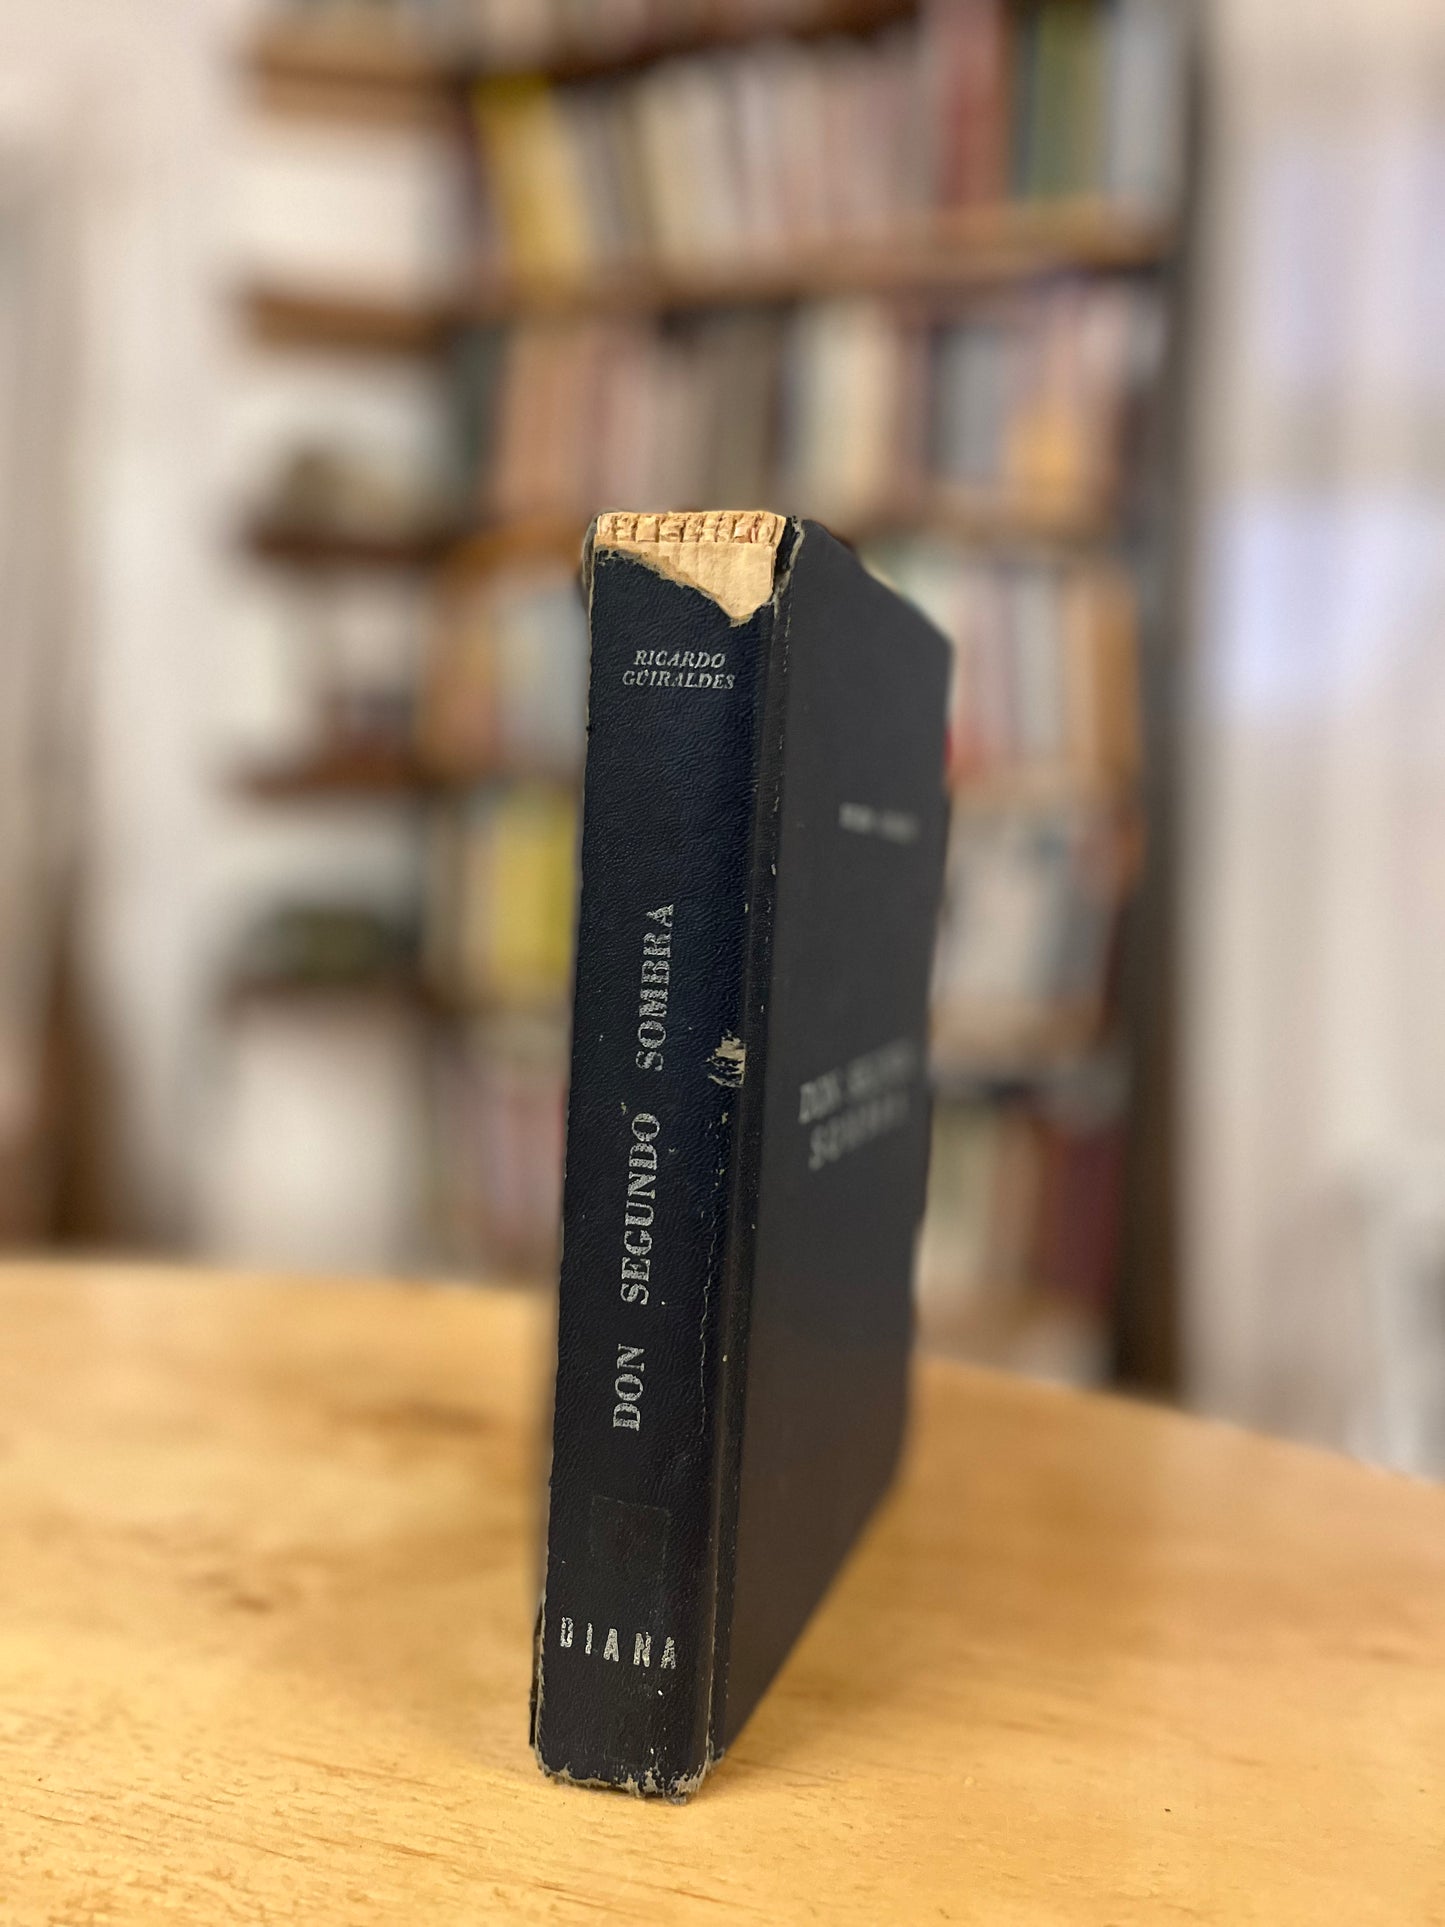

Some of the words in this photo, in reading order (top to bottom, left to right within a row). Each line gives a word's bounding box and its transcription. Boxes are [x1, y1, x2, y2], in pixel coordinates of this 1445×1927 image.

[633, 650, 726, 669] RICARDO
[636, 904, 674, 1071] SOMBRA
[620, 1113, 661, 1305] SEGUNDO
[613, 1344, 645, 1431] DON
[560, 1616, 676, 1670] DIANA
